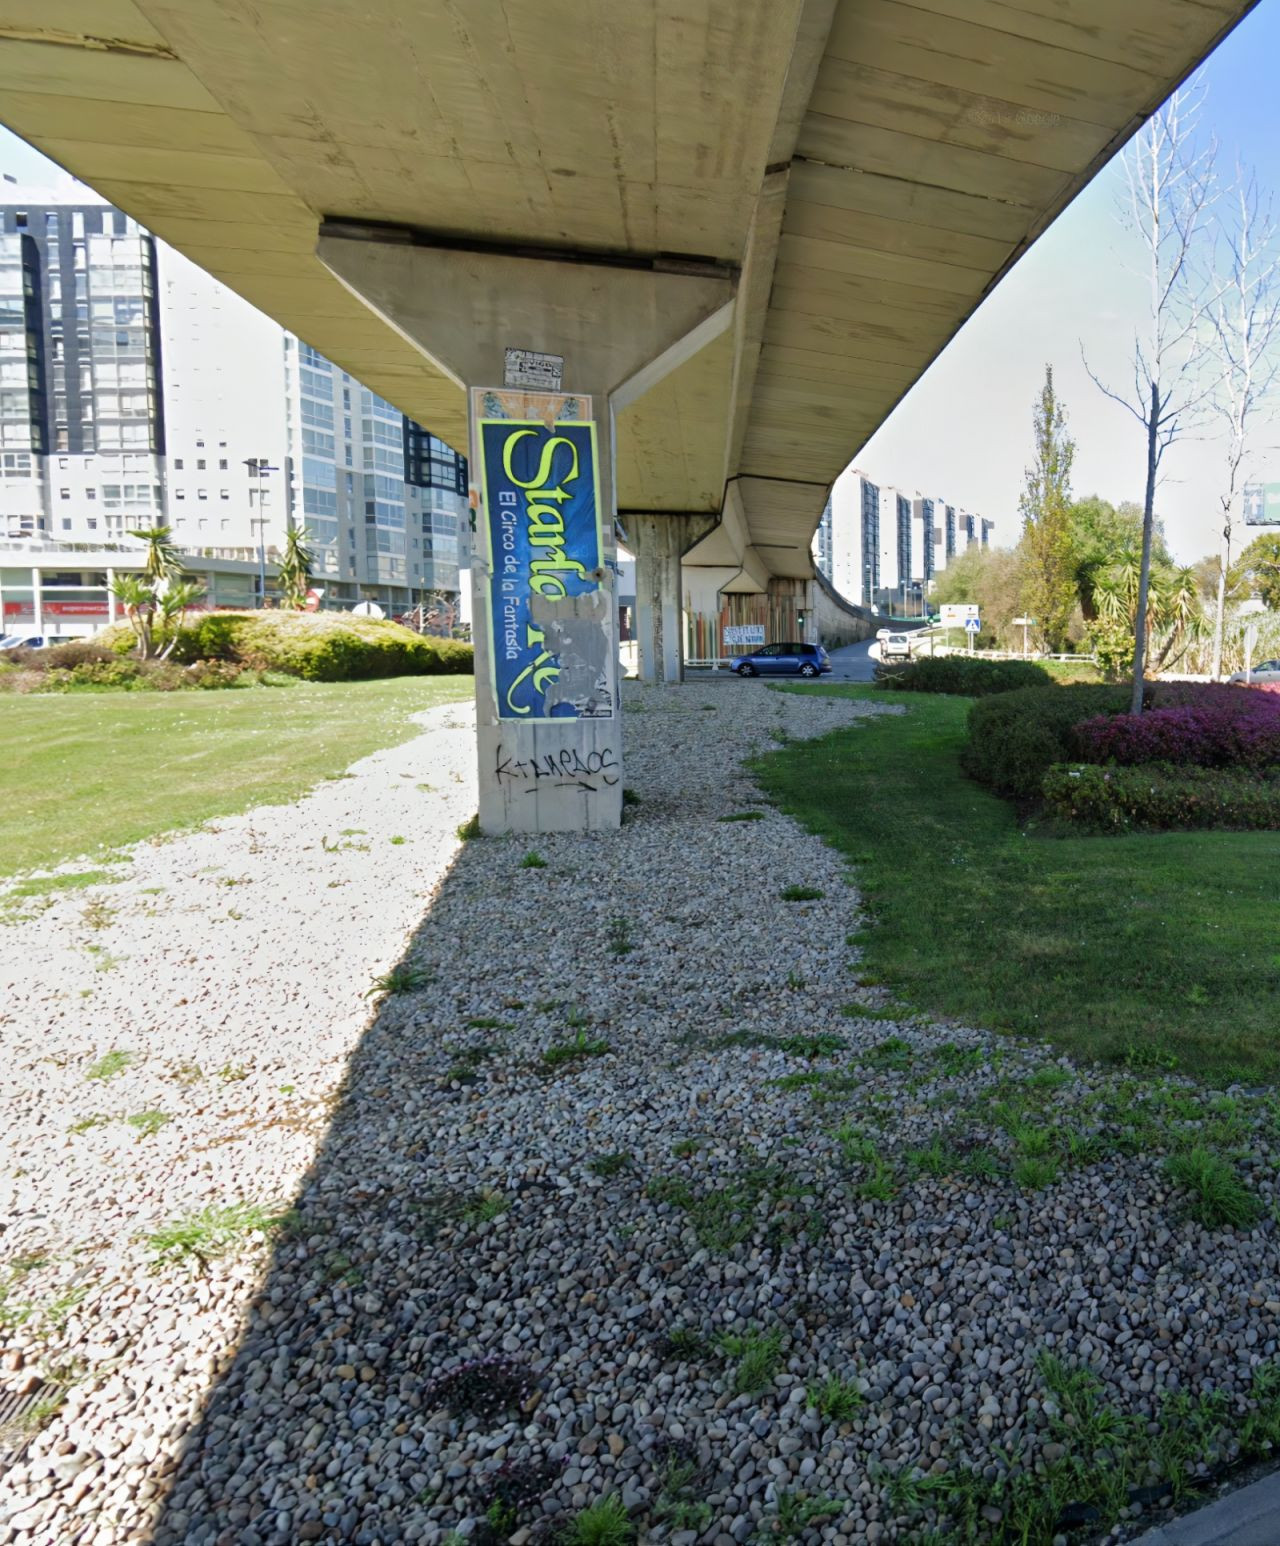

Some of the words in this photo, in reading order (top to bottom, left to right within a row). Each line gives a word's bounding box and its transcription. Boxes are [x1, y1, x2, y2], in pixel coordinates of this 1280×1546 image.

[499, 491, 517, 506] El
[501, 512, 517, 551] Circo
[503, 555, 520, 573] de
[502, 577, 519, 592] la
[504, 597, 520, 660] Fantasía
